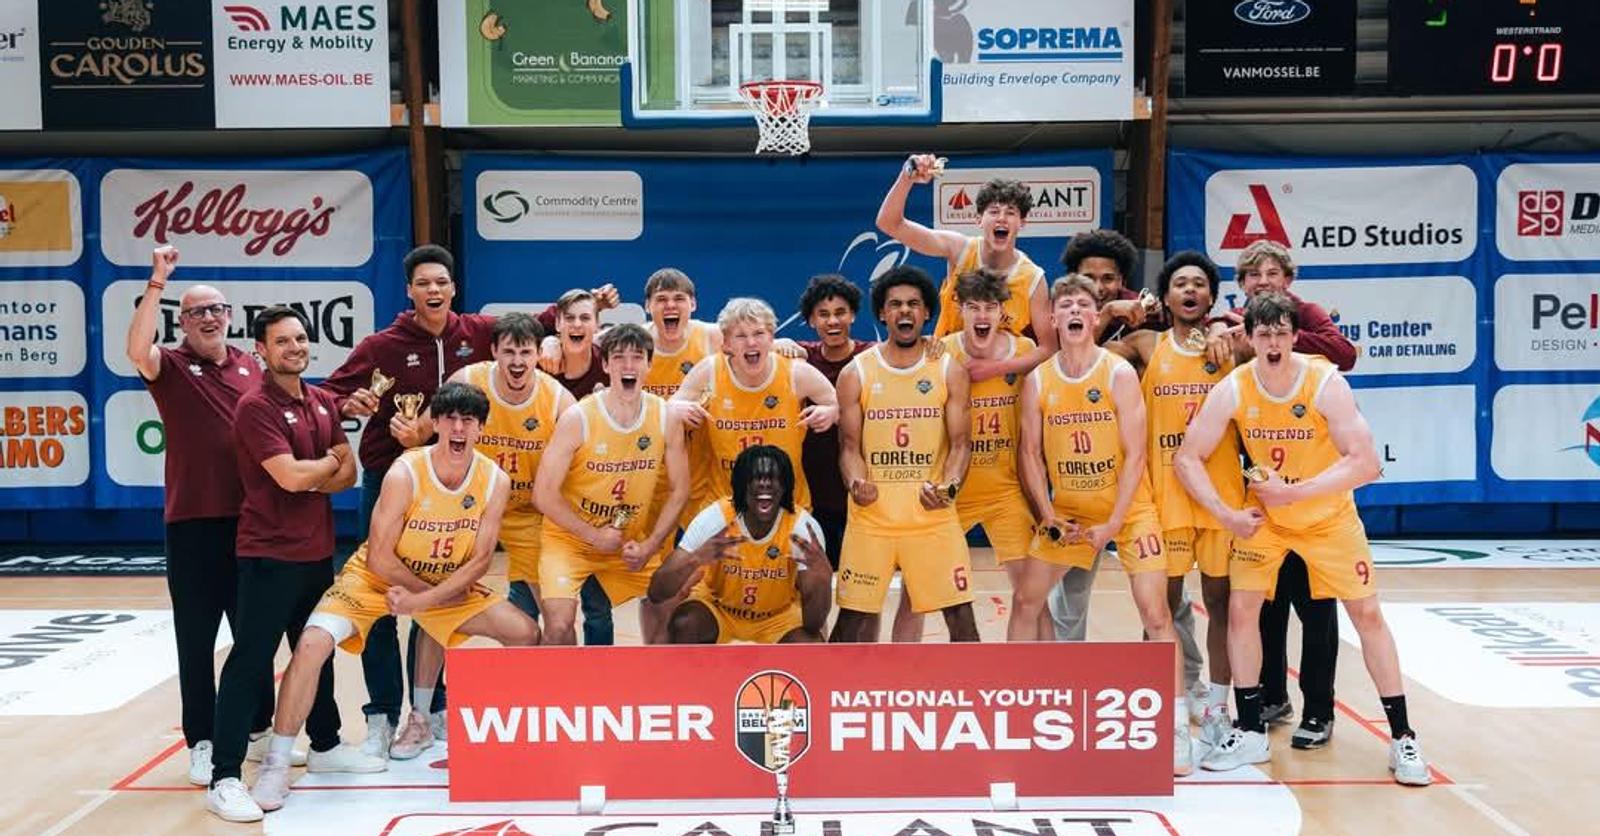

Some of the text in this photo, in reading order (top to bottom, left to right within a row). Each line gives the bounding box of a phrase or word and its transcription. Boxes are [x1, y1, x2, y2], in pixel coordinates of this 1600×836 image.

[280, 5, 377, 31] MAES
[87, 37, 166, 51] GOUDEN
[228, 36, 374, 52] Energy & Mobilty
[977, 27, 1122, 49] SOPREMA
[50, 52, 206, 84] CAROLUS
[512, 52, 555, 66] Green
[230, 73, 374, 86] WWW.MAES-OIL.BE
[943, 72, 1121, 86] Building Envelope Company
[1223, 66, 1320, 78] VANMOSSEL.BE
[535, 195, 638, 207] Commodity Centre
[134, 181, 336, 256] Kellogg's
[1302, 223, 1463, 249] AED Studios
[1367, 320, 1433, 338] Center
[1369, 343, 1457, 358] CAR DETAILING
[1531, 339, 1587, 351] DESIGN
[20, 347, 57, 365] Berg
[867, 407, 941, 420] OOSTENDE
[976, 411, 1001, 435] 14
[716, 418, 787, 431] OOSTENDE
[895, 423, 910, 448] 6
[1070, 430, 1092, 455] 10
[496, 452, 518, 473] 11
[586, 459, 656, 473] OOSTENDE
[871, 451, 933, 465] COREtec
[1271, 447, 1285, 471] 9
[611, 479, 626, 501] 4
[408, 518, 478, 532] OOSTENDE
[429, 536, 455, 559] 15
[1133, 533, 1161, 559] 10
[953, 566, 968, 591] 6
[1354, 560, 1370, 585] 9
[743, 586, 758, 605] 8
[830, 689, 1073, 707] NATIONAL YOUTH
[1095, 688, 1163, 719] 20
[460, 705, 715, 743] WINNER
[829, 711, 1076, 751] FINALS
[1095, 720, 1158, 750] 25
